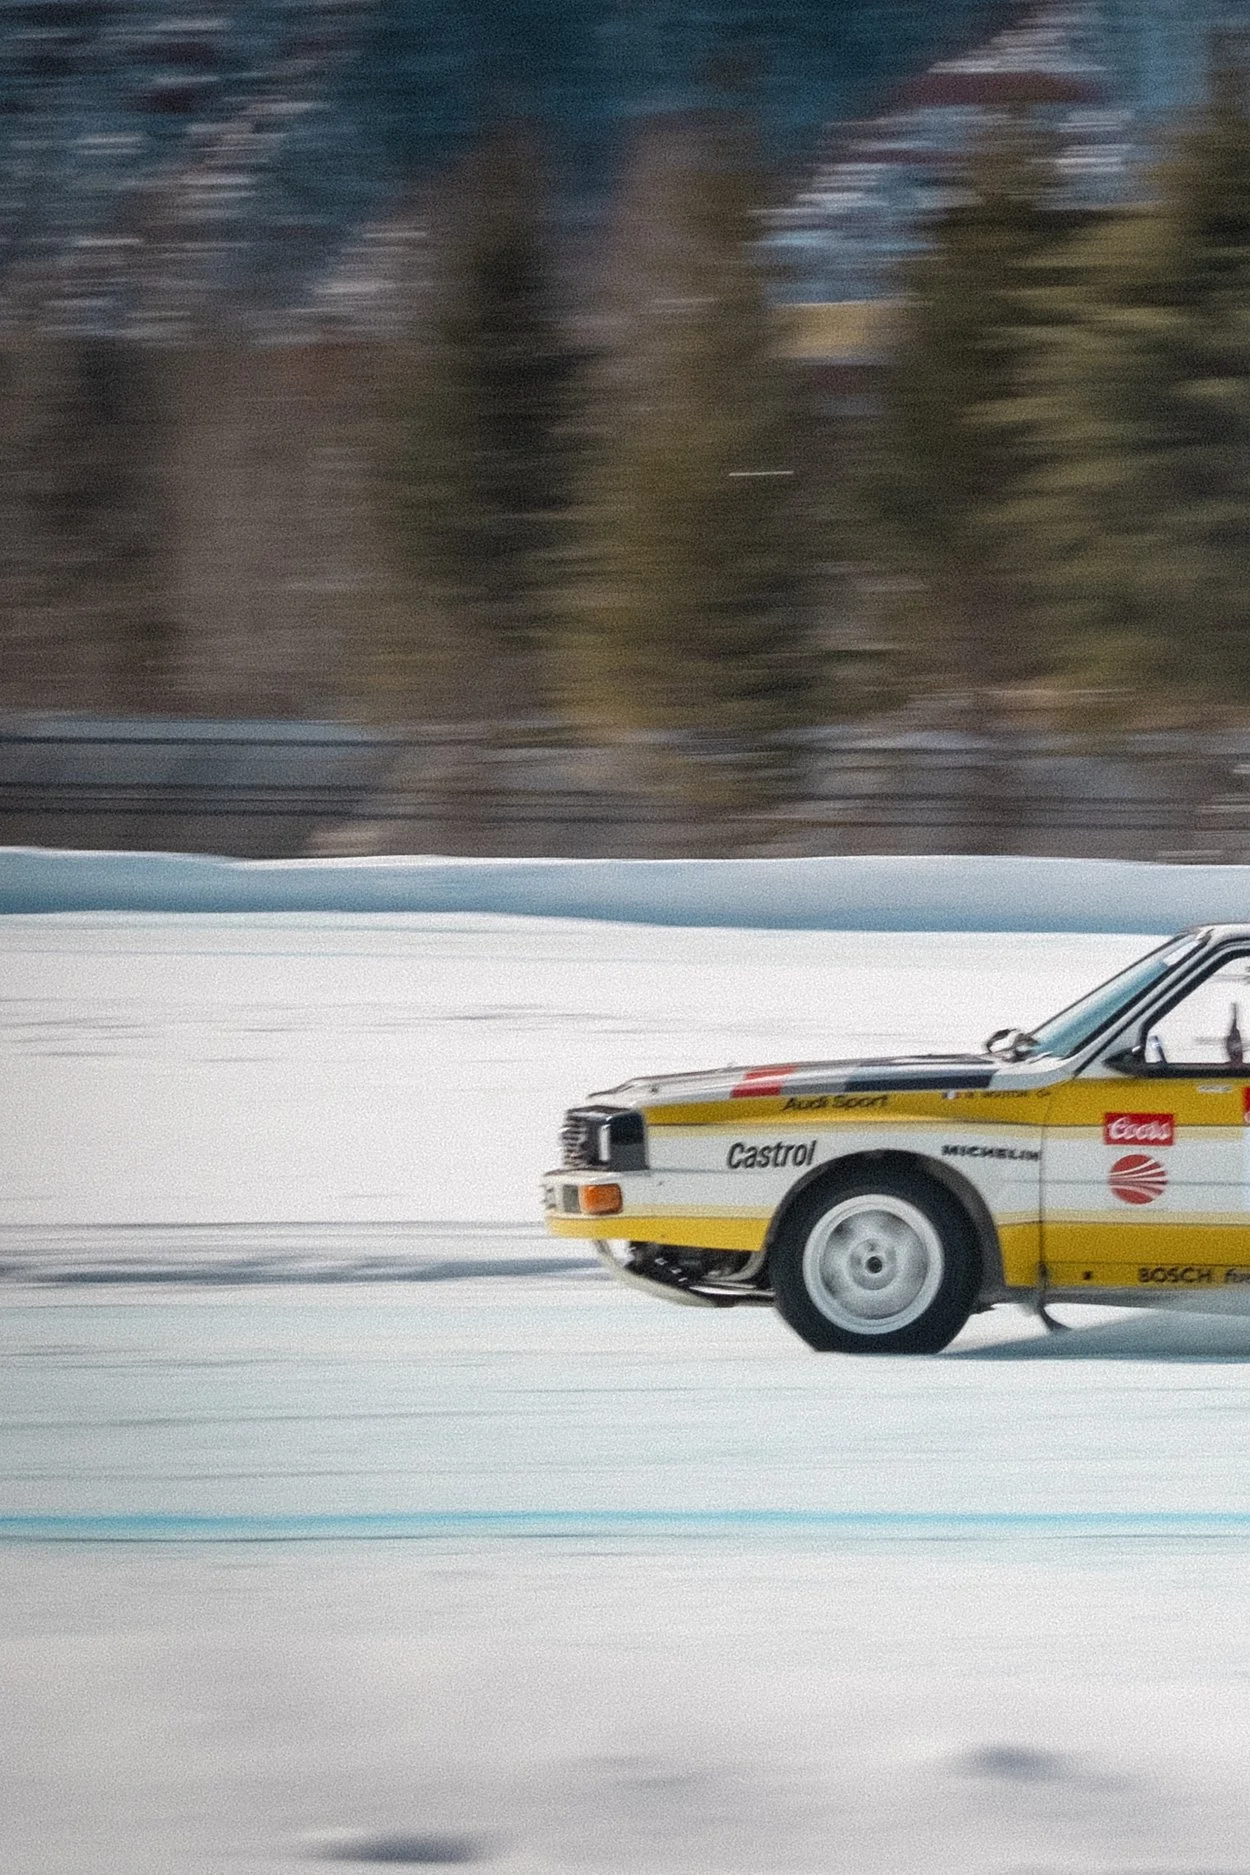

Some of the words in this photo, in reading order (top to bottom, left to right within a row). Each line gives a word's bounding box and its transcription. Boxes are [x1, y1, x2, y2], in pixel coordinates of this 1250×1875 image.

[782, 1095, 830, 1112] Audi
[831, 1094, 889, 1111] Sport
[726, 1139, 818, 1169] Castrol
[941, 1144, 1042, 1162] MICHELIN
[1138, 1267, 1214, 1284] BOSCH
